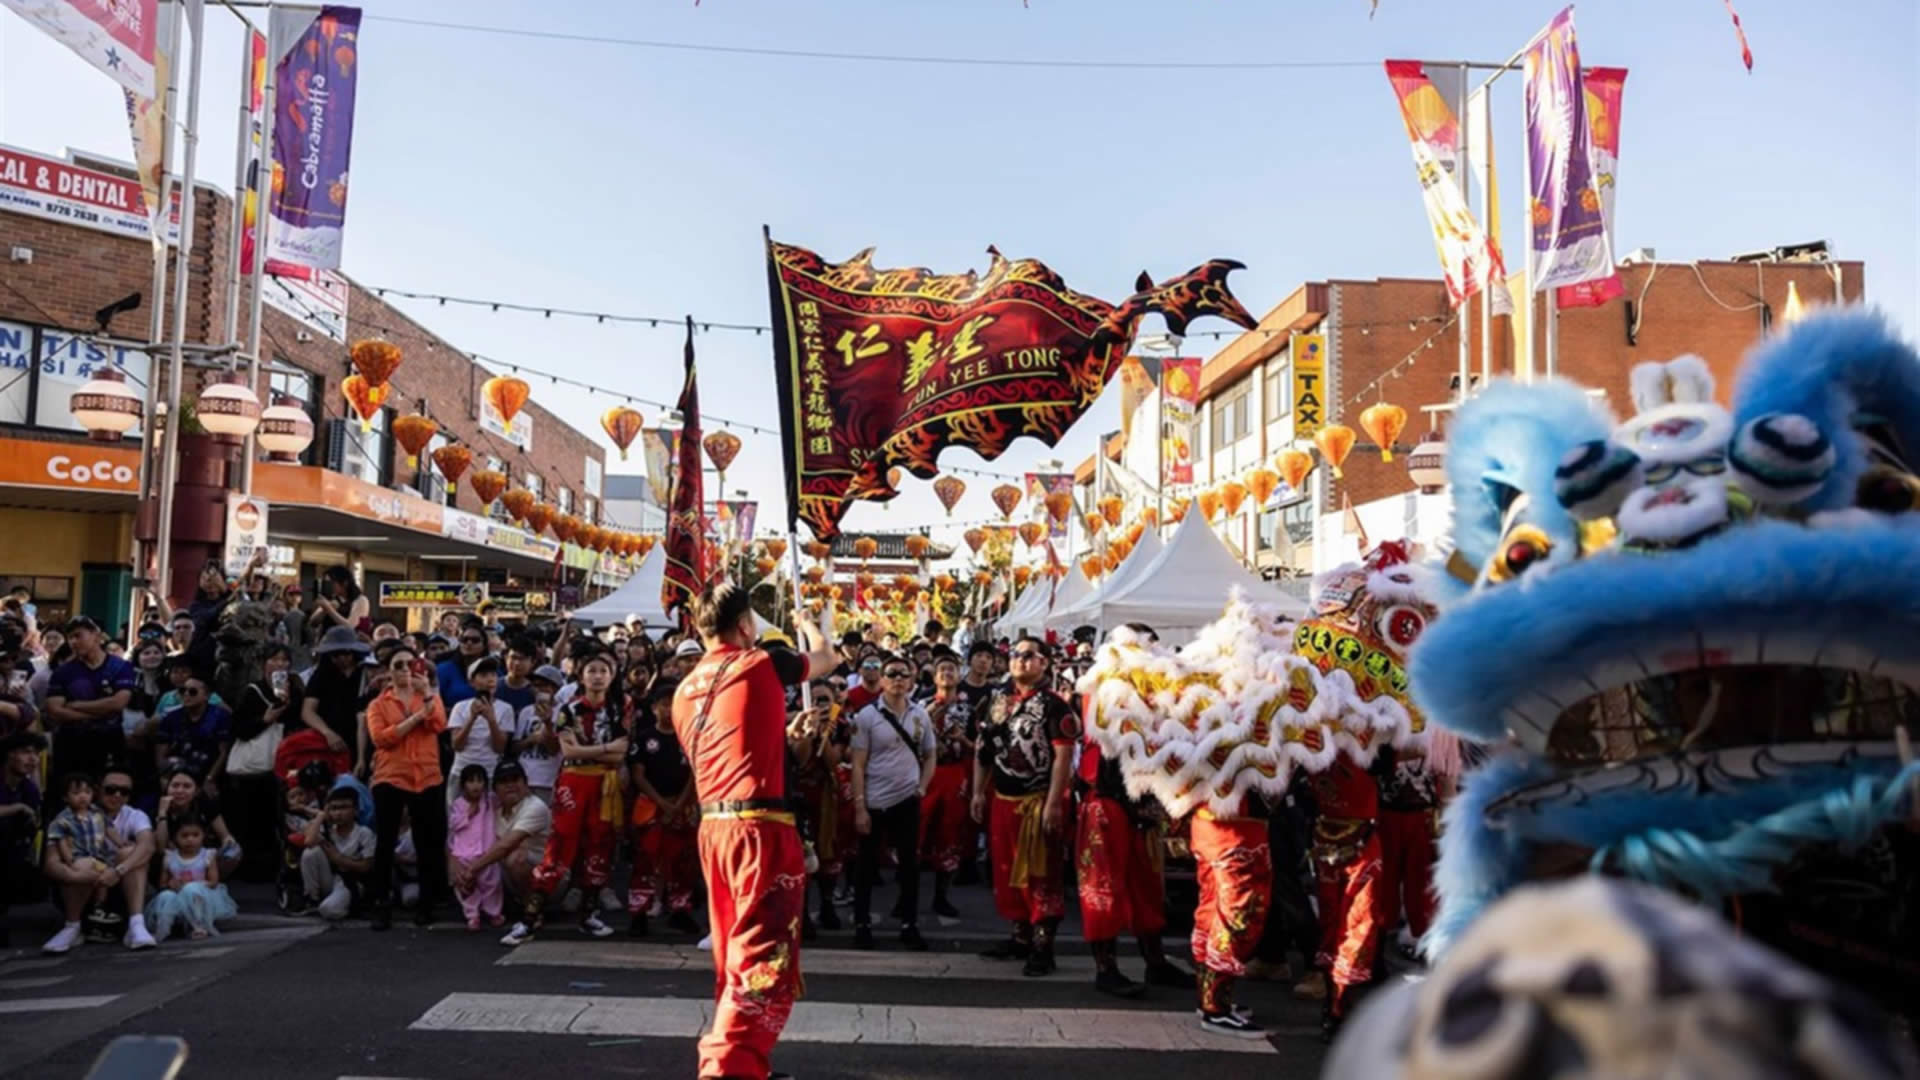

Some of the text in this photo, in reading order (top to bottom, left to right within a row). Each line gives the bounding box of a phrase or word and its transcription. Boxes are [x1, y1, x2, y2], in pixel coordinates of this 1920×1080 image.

[301, 74, 329, 189] Cabramatta
[36, 166, 50, 190] &
[58, 170, 128, 207] DENTAL
[74, 208, 99, 223] 2638
[951, 359, 989, 385] YEE
[1004, 348, 1062, 369] TONG
[1298, 374, 1320, 424] TAX
[47, 455, 133, 483] CoCo
